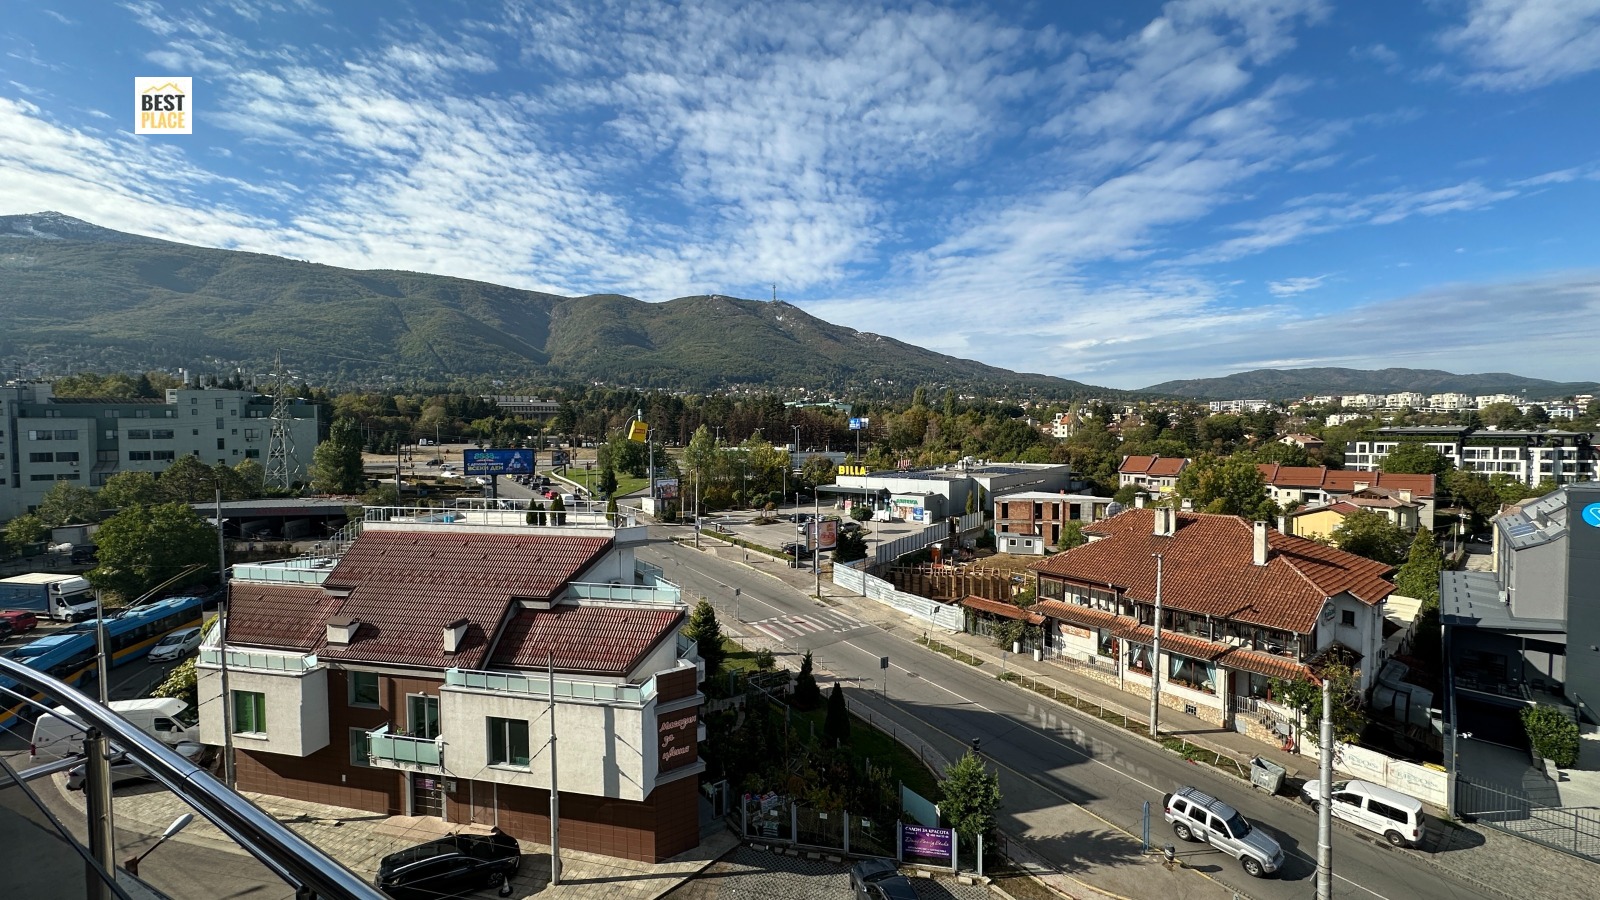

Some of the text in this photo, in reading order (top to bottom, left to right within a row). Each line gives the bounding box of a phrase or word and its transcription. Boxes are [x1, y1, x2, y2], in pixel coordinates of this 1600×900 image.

[838, 465, 866, 476] BILLA
[659, 715, 697, 732] Магазин
[661, 734, 675, 747] за
[662, 745, 690, 761] цветя
